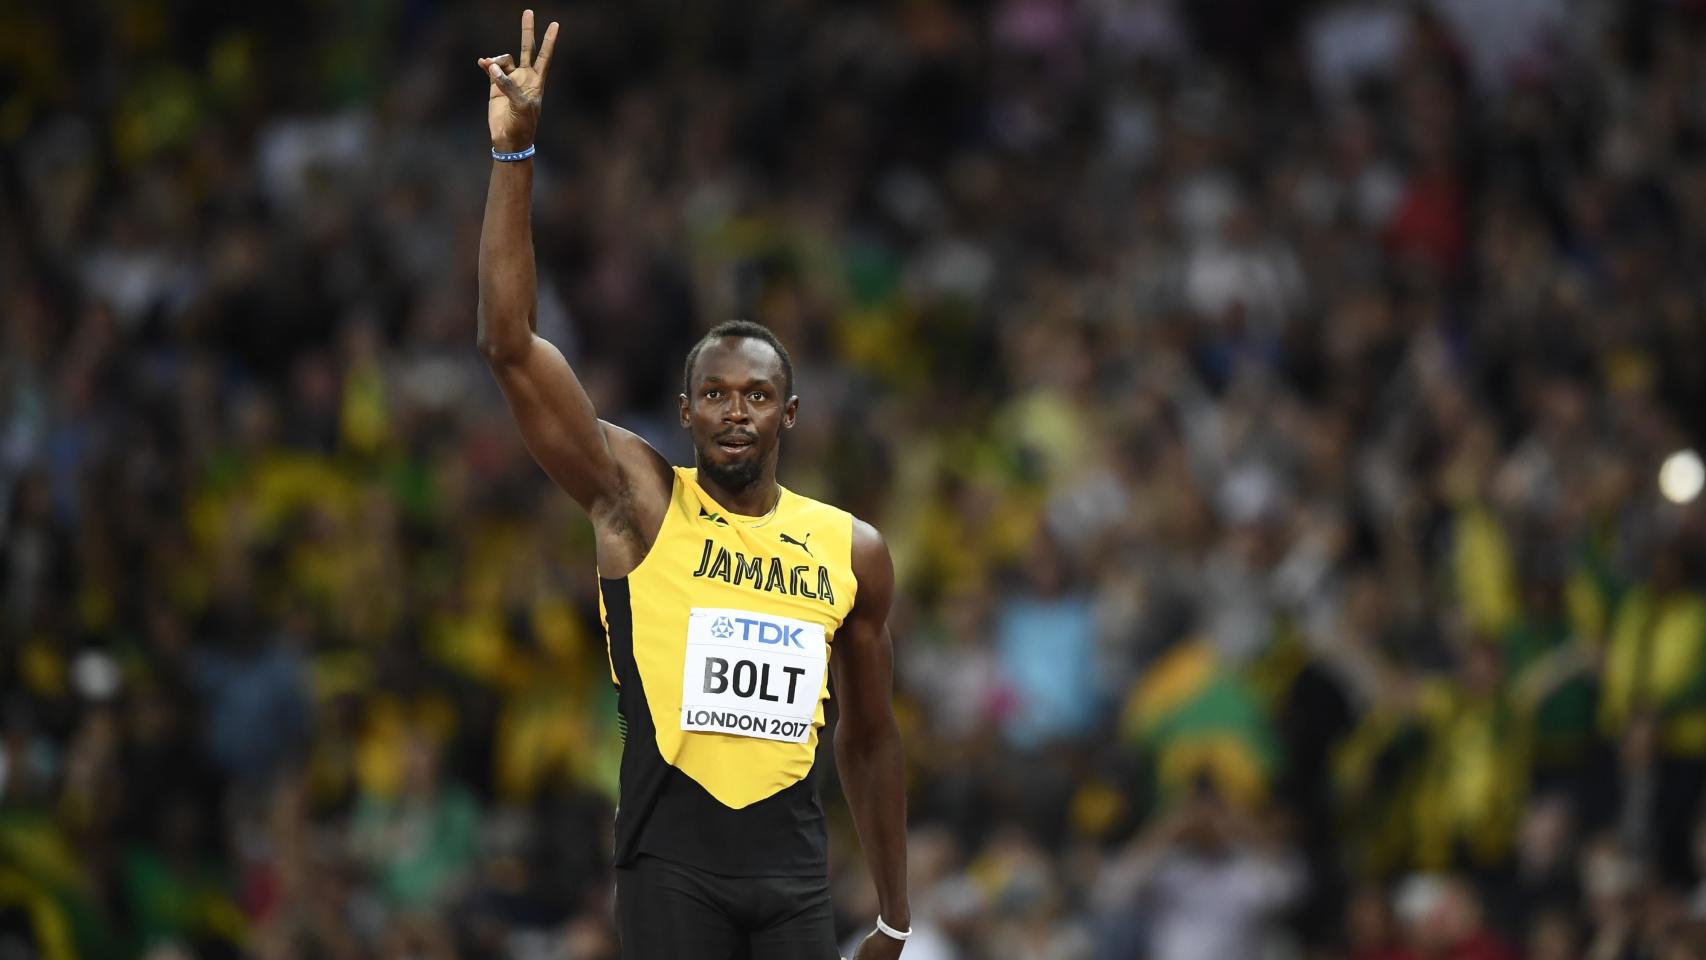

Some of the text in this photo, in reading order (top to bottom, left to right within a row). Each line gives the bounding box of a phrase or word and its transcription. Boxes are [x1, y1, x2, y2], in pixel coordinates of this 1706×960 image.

[693, 539, 835, 605] JAMAICA
[735, 618, 805, 649] TDK
[703, 657, 805, 704] BOLT
[686, 710, 808, 738] LONDON 2017
